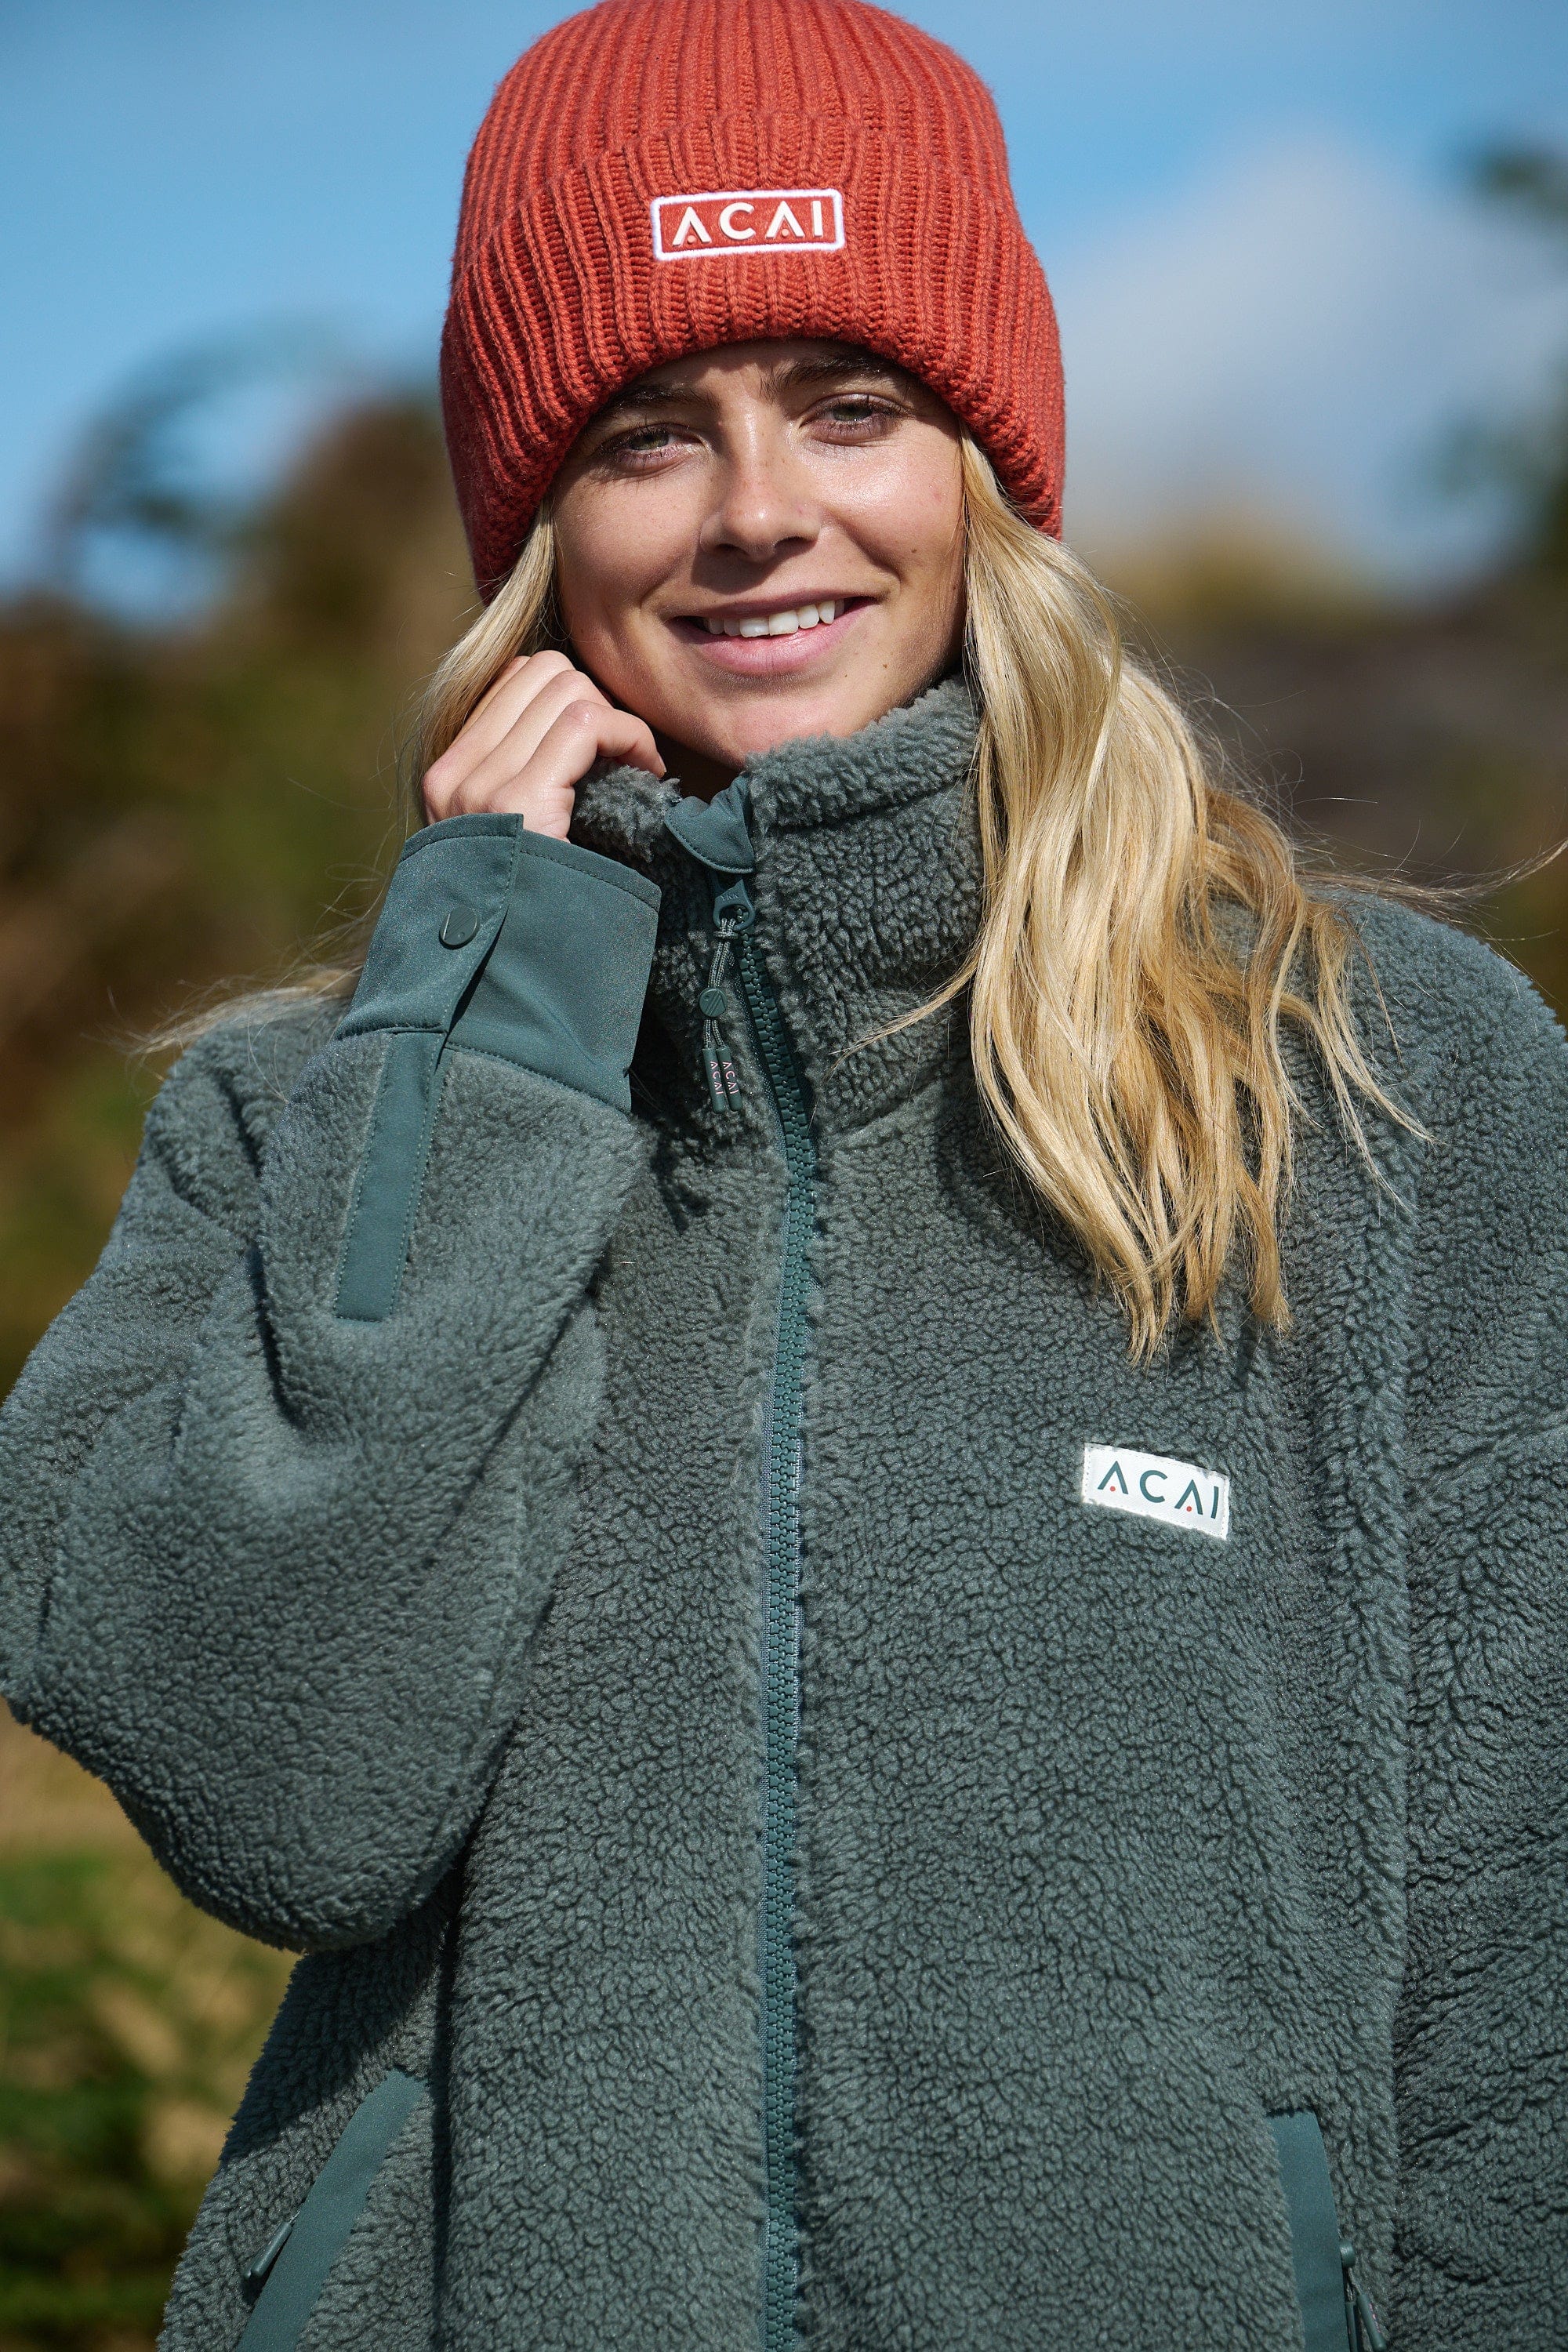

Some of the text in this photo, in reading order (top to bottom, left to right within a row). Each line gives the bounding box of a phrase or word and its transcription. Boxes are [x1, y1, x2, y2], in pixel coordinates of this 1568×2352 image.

[672, 200, 823, 246] ACAI
[710, 1061, 724, 1094] ACAI
[722, 1061, 739, 1094] ACAI
[1097, 1460, 1220, 1519] ACAI
